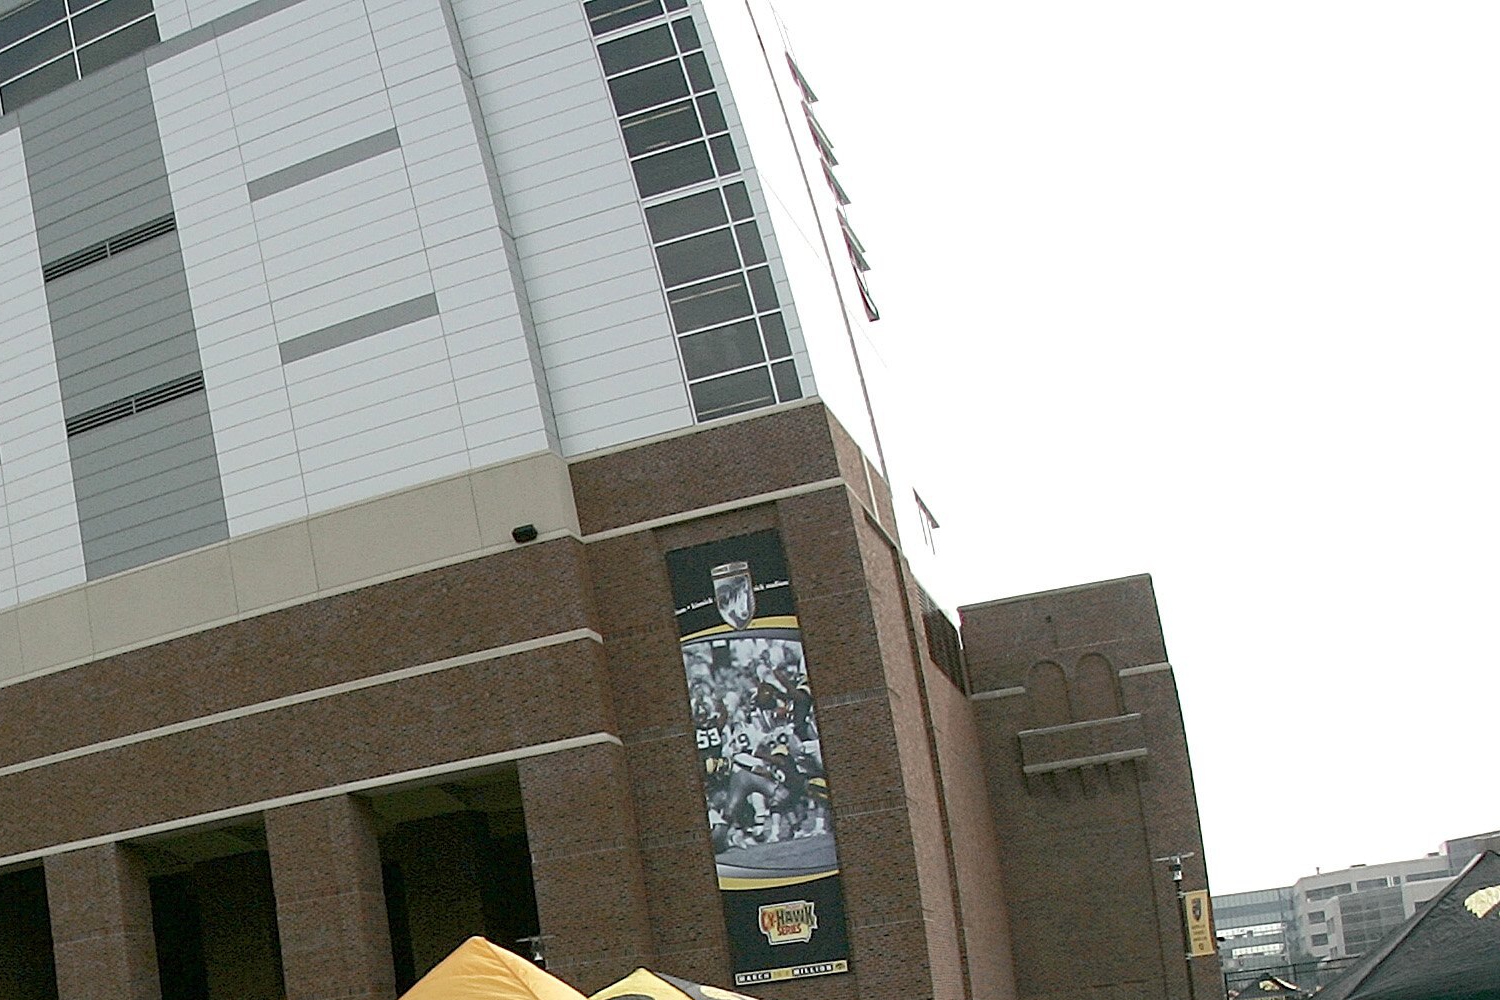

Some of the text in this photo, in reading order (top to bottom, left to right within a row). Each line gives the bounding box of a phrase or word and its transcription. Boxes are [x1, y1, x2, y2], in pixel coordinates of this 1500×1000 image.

[696, 727, 722, 749] 53
[777, 923, 802, 936] SERIES
[739, 972, 770, 982] MARCH
[793, 964, 833, 976] MILLION
